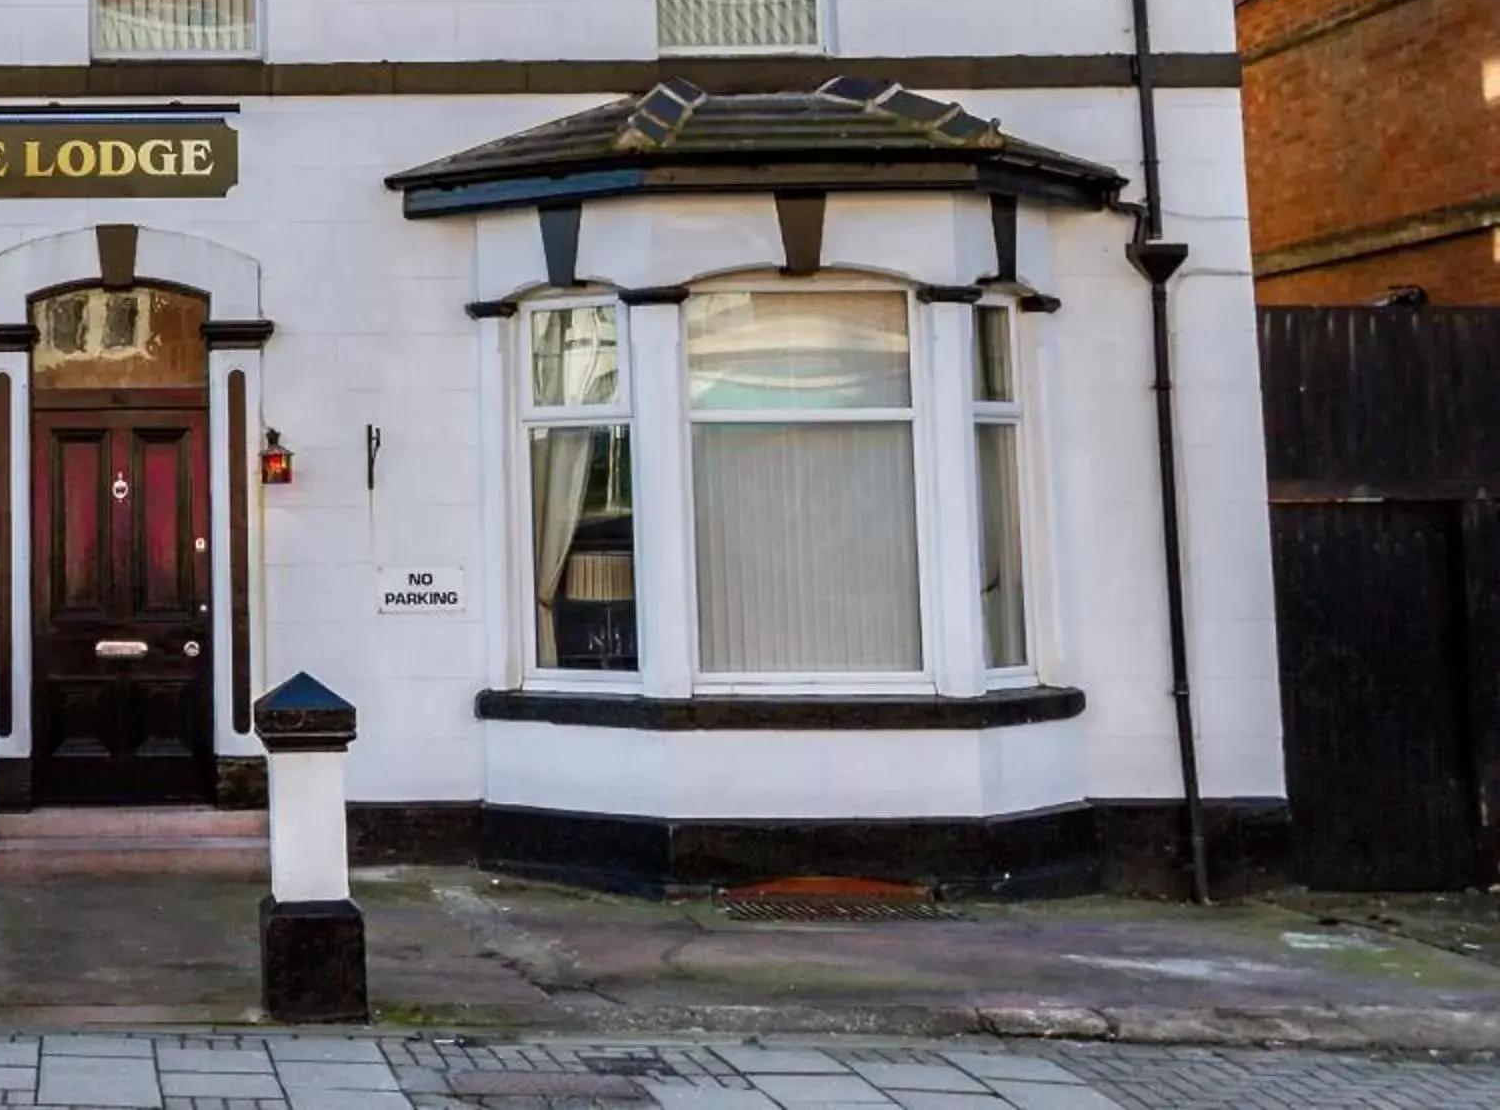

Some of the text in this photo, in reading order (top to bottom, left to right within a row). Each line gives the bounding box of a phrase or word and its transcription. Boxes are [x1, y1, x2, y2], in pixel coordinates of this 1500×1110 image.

[25, 138, 215, 179] LODGE
[408, 573, 433, 586] NO
[385, 591, 458, 605] PARKING
